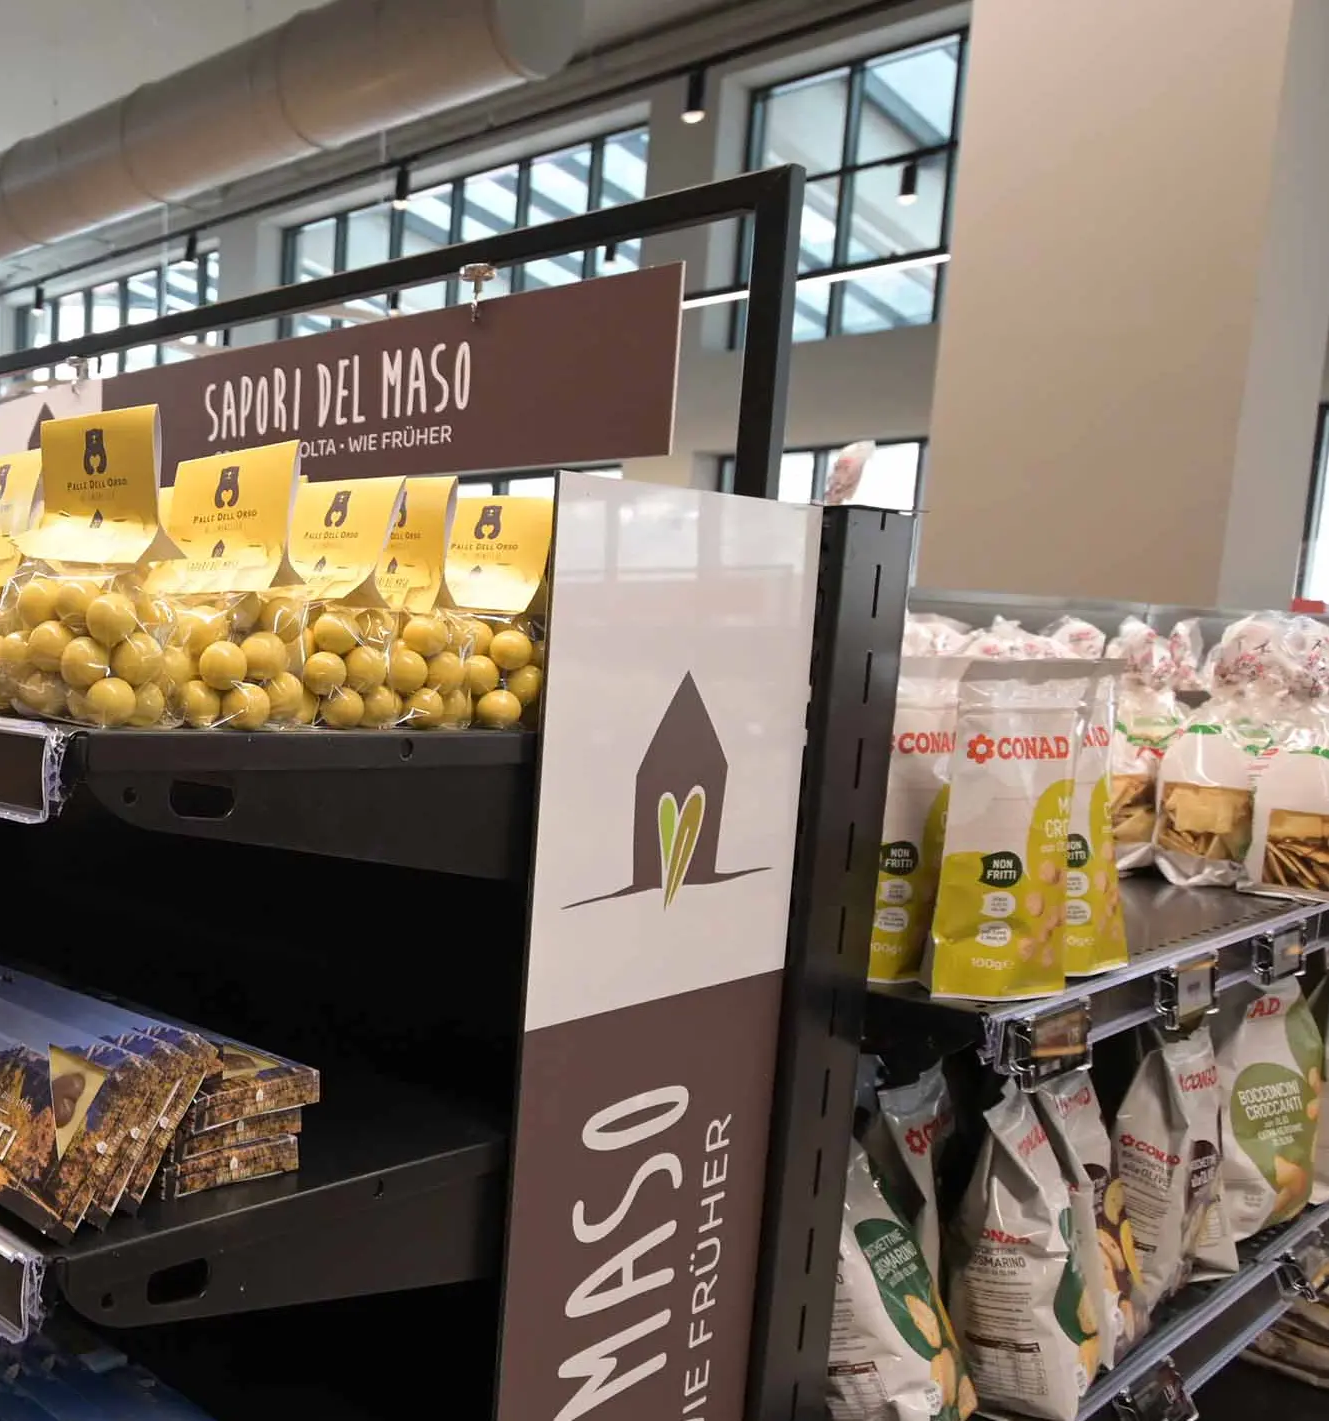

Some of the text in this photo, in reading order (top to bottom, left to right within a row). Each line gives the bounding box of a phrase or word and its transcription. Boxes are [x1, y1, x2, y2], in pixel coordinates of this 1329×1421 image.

[204, 341, 471, 442] SAPORI DEL MASO
[298, 425, 453, 459] OLTA WIE FRÜHER
[897, 732, 957, 755] CONA
[997, 736, 1070, 761] CONAD
[890, 848, 910, 858] NON
[992, 859, 1013, 869] NON
[986, 869, 1017, 880] FRITTI
[1237, 1079, 1300, 1106] BOCCONCINI
[1245, 1095, 1303, 1121] CROCCANTI
[688, 1113, 732, 1349] FRÜHER
[553, 1085, 689, 1421] MASO
